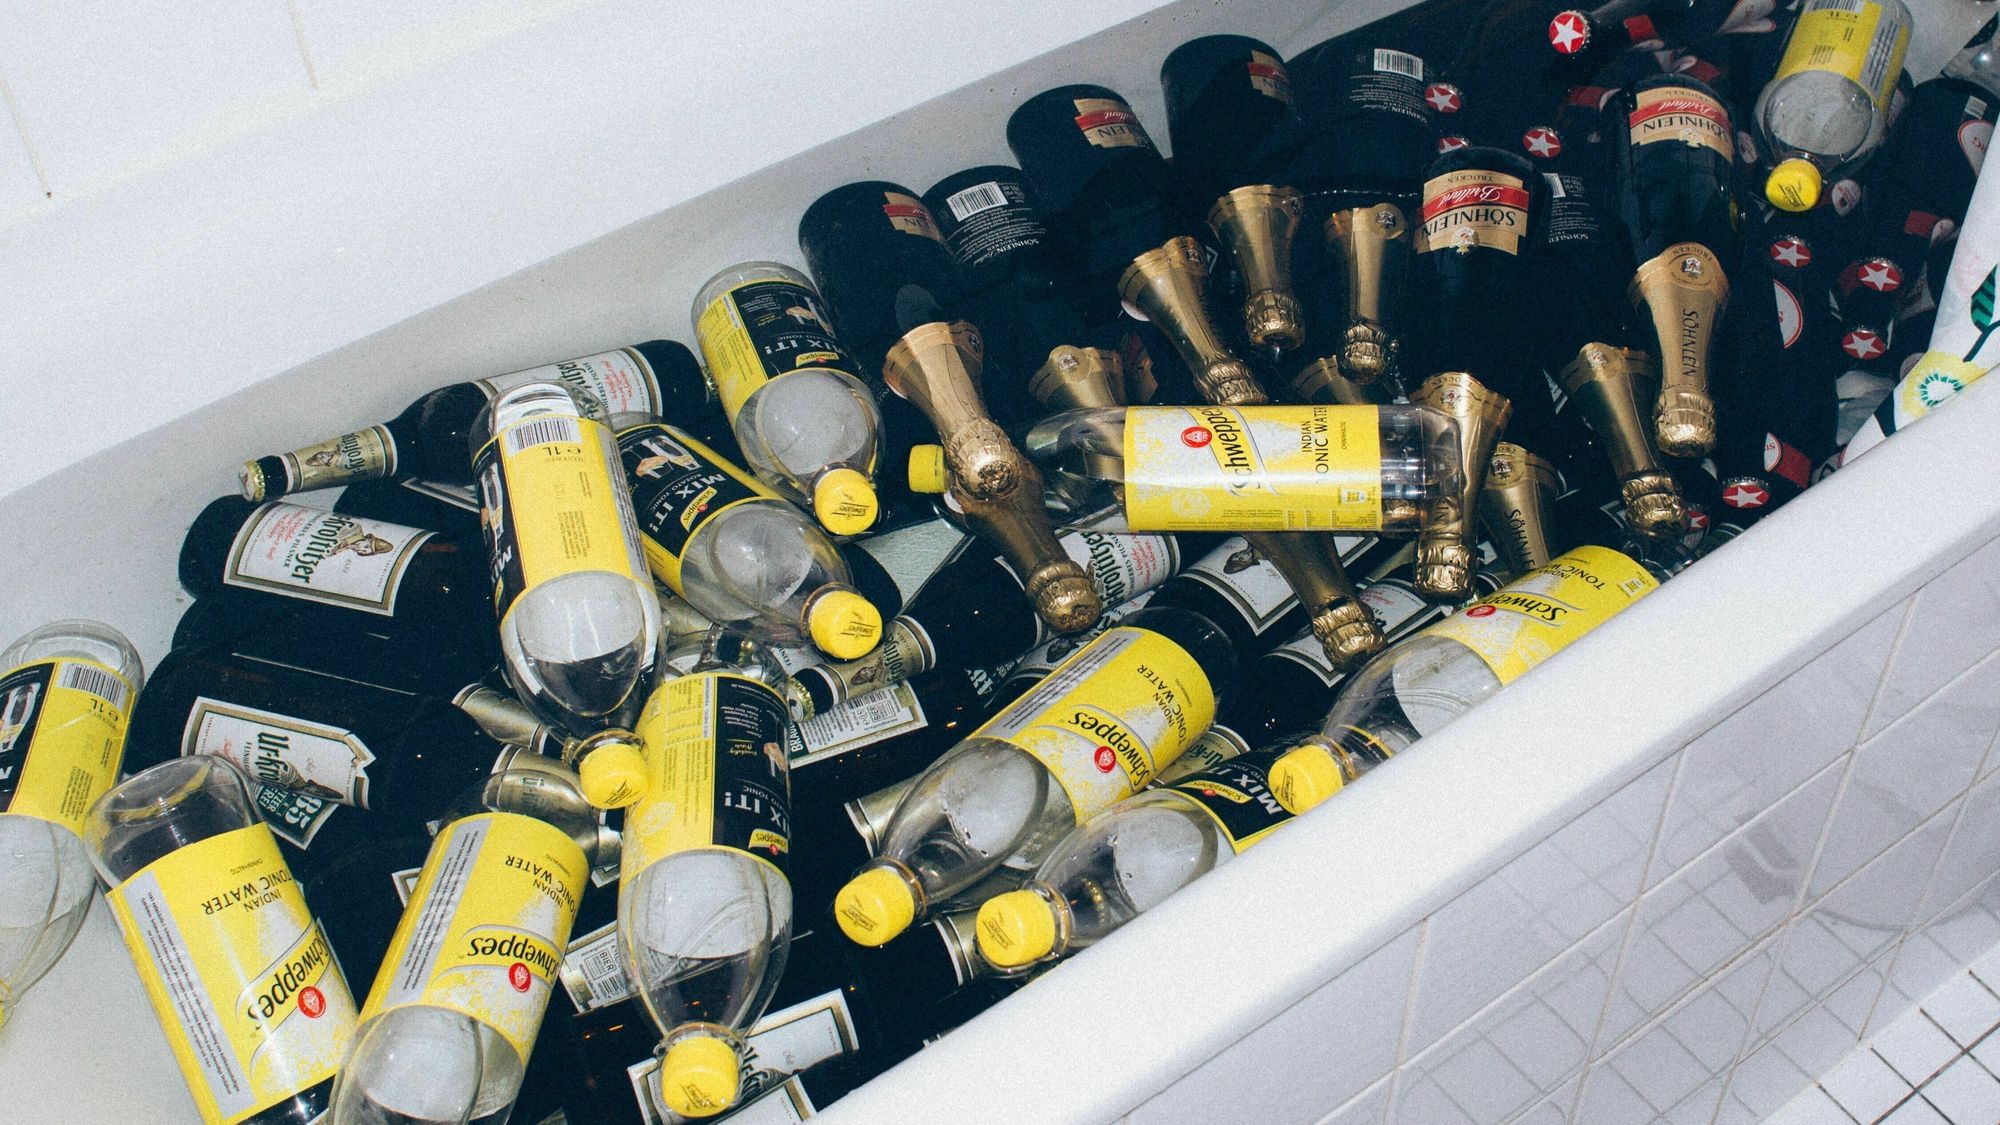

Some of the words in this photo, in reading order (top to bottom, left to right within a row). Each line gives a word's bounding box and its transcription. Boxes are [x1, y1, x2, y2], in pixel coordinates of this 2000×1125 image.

[1659, 99, 1716, 119] Brillant
[1446, 174, 1495, 184] TROCKEN
[1440, 186, 1505, 208] Brillant
[1420, 208, 1517, 238] SÖHNLEIN
[1672, 244, 1713, 263] TROCKEN
[763, 338, 797, 356] IT!
[1682, 307, 1699, 378] SÖHNLEIN
[1301, 419, 1311, 453] INDIAN
[674, 473, 726, 499] MIX
[648, 501, 675, 533] IT!
[1136, 663, 1176, 707] WATER
[1152, 691, 1175, 729] INDIAN
[1170, 704, 1190, 747] TONIC
[1067, 711, 1151, 788] Schweppes
[723, 790, 761, 815] IT!
[741, 785, 772, 801] TONIC
[1231, 772, 1284, 815] MIX
[257, 867, 293, 895] TONIC
[504, 854, 555, 886] WATER
[201, 882, 256, 916] WATER
[243, 888, 283, 914] INDIAN
[533, 878, 565, 909] INDIAN
[599, 948, 615, 971] BIER
